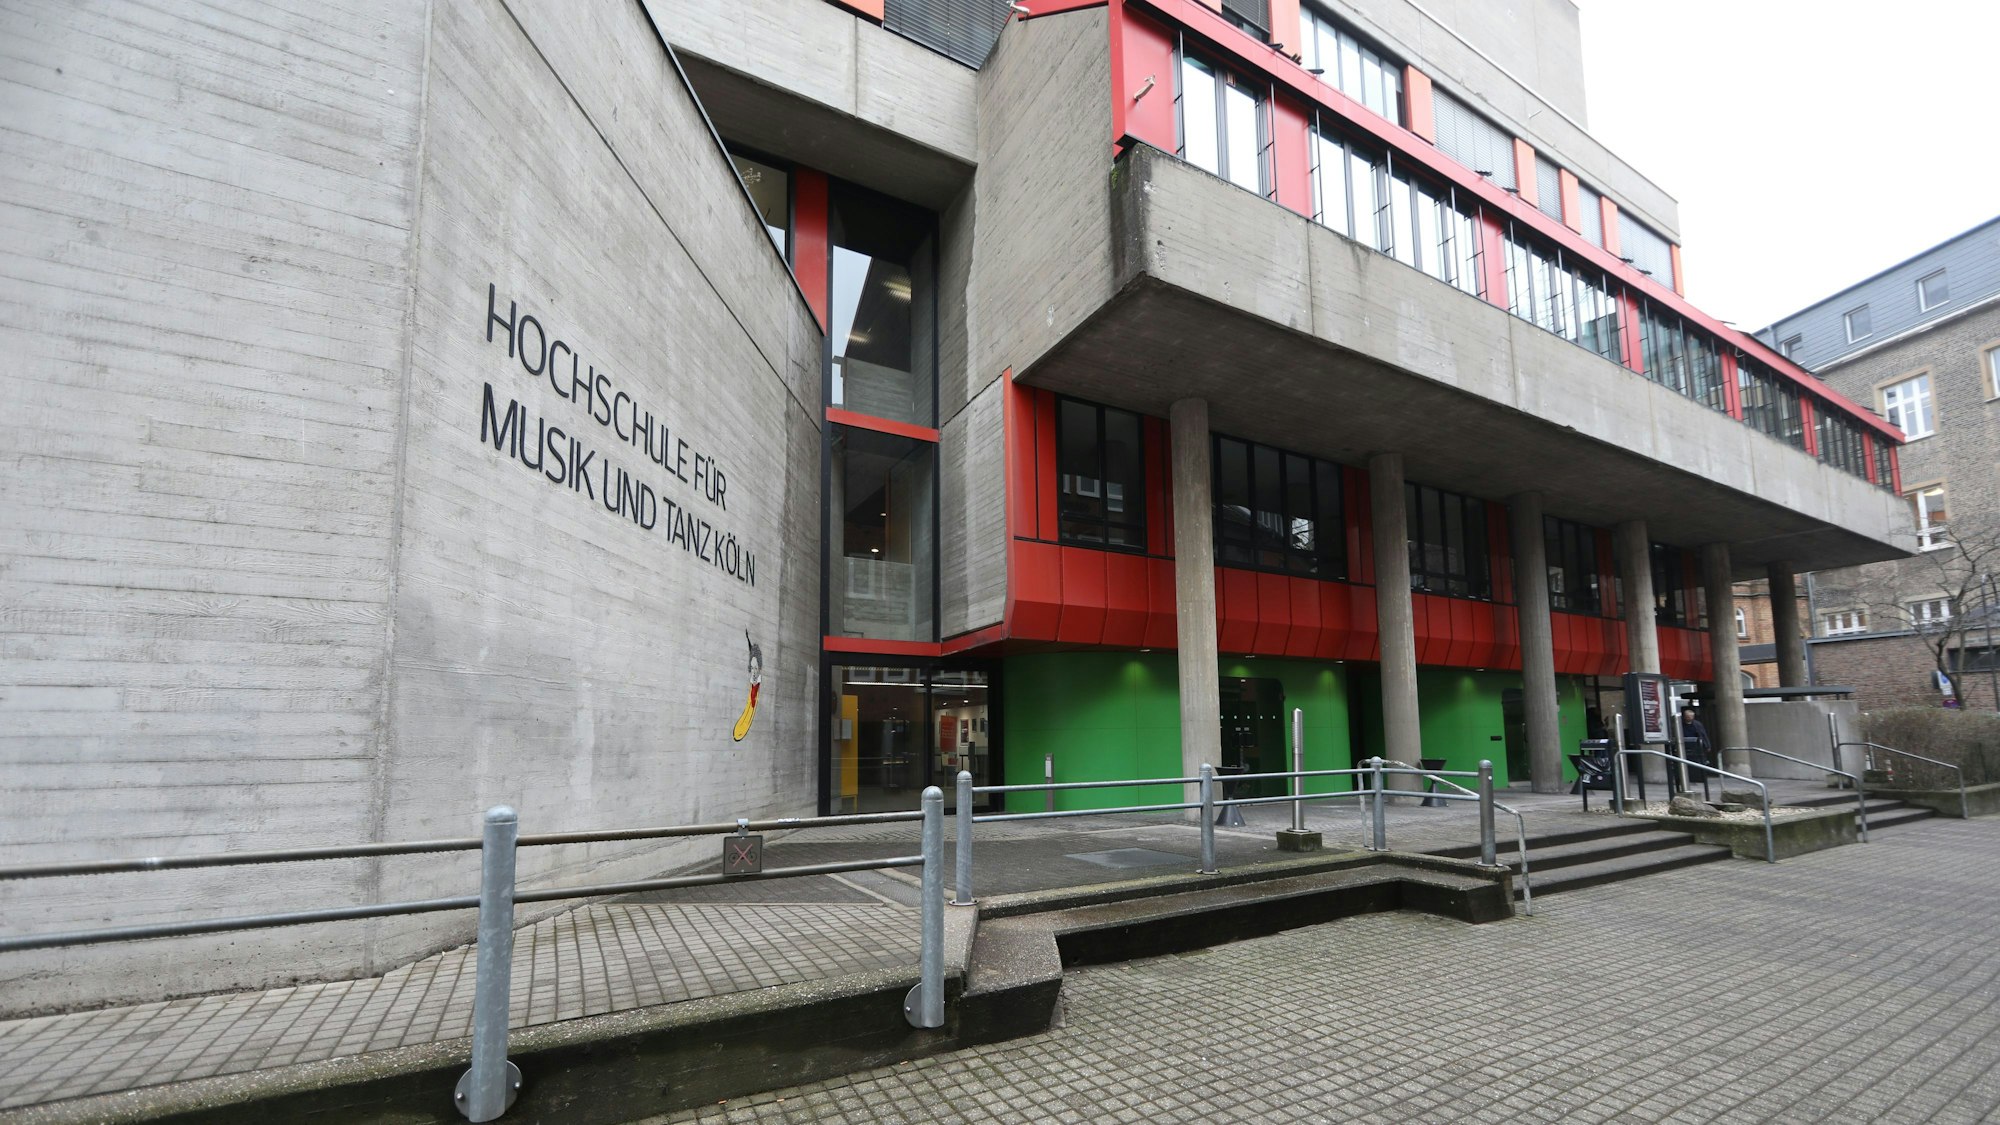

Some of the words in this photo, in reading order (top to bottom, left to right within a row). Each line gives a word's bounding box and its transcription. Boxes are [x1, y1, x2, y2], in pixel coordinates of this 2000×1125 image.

[480, 382, 596, 500] MUSIK
[603, 459, 657, 530] UND
[663, 496, 711, 562] TANZ
[714, 530, 755, 587] KÖLN
[487, 282, 689, 483] HOCHSCHULE
[694, 452, 727, 511] FÜR
